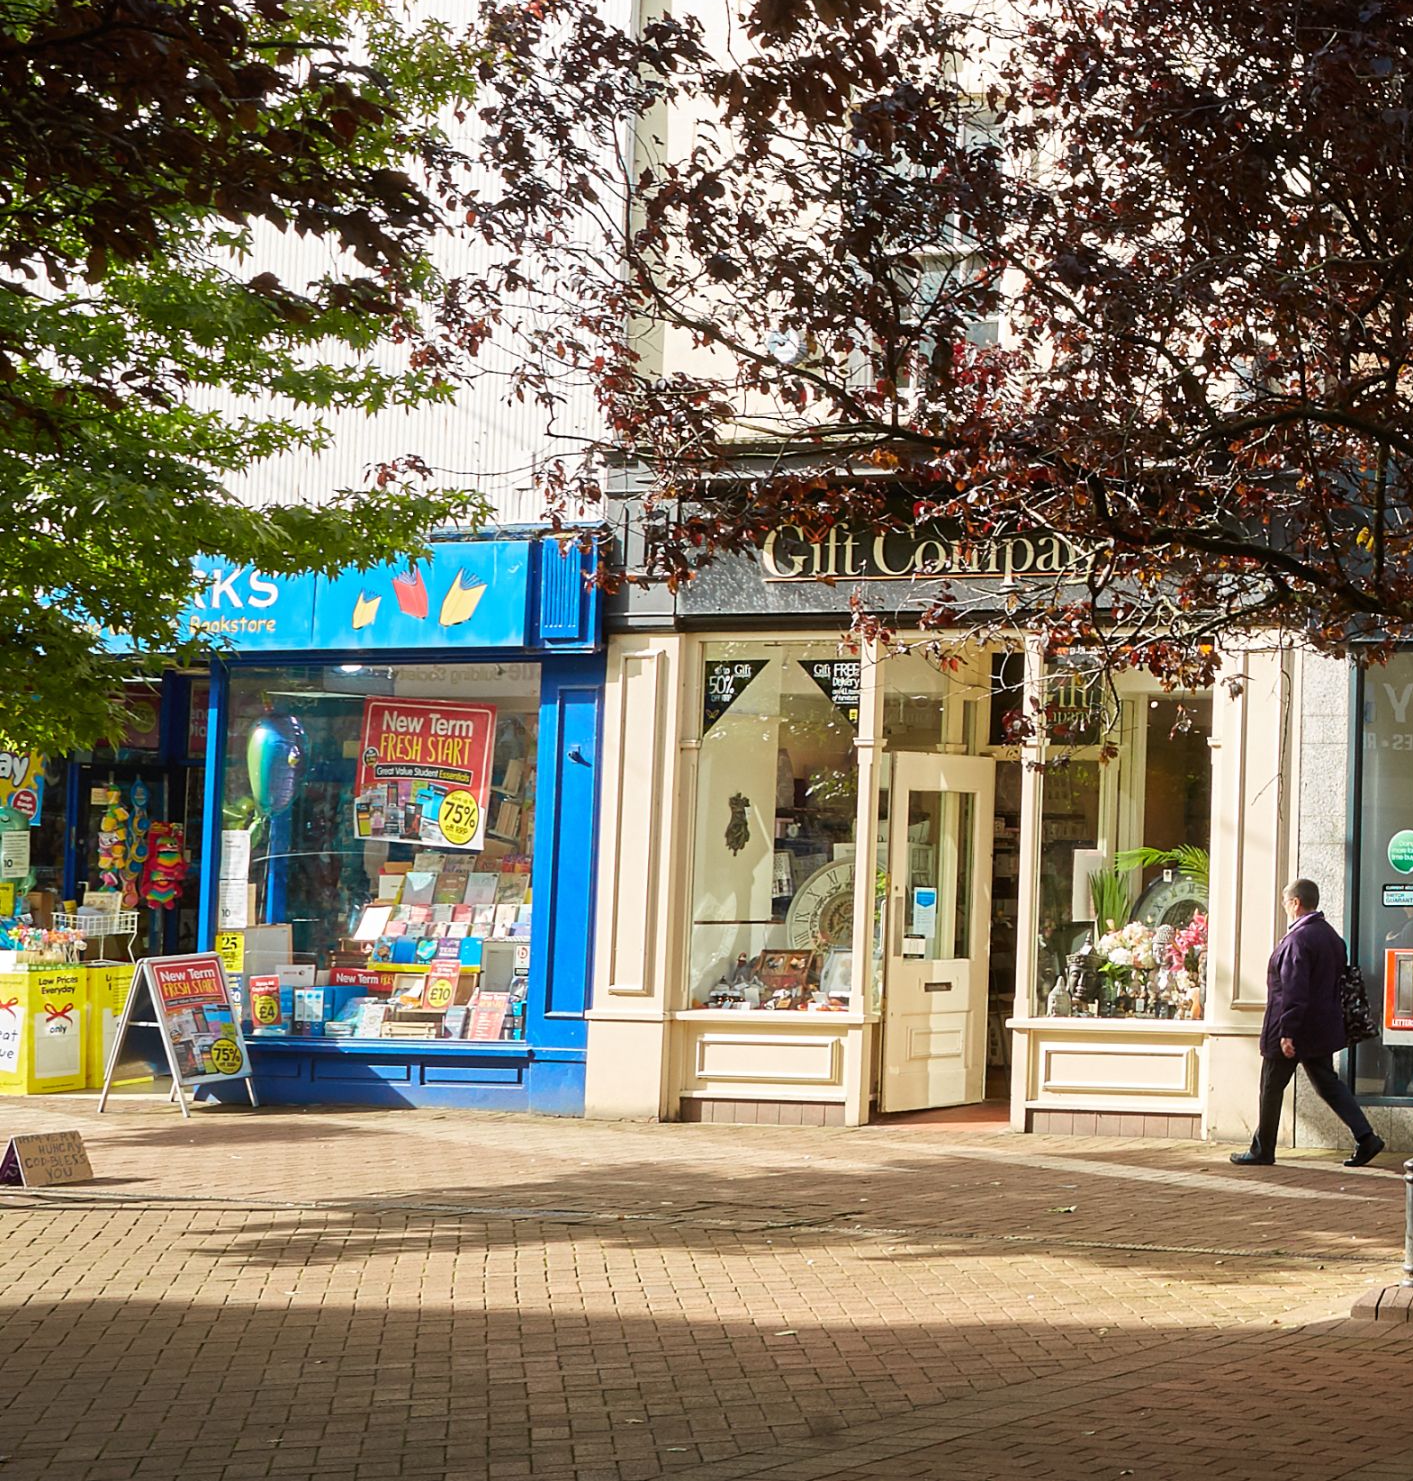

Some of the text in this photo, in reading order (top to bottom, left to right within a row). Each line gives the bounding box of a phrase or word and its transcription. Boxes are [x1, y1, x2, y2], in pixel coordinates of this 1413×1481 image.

[762, 522, 862, 578] Gift
[833, 663, 860, 677] FREE
[382, 710, 474, 737] New Term
[380, 733, 472, 767] FRESH START
[443, 801, 477, 829] 75%
[38, 976, 79, 986] Low Prices
[160, 968, 216, 983] New Term
[335, 973, 356, 984] New
[358, 973, 379, 984] Term
[41, 986, 76, 996] Everyday
[162, 978, 219, 998] FRESH START
[430, 986, 451, 1001] £10
[258, 1006, 275, 1019] £4
[49, 1024, 68, 1035] only
[213, 1046, 241, 1062] 75%
